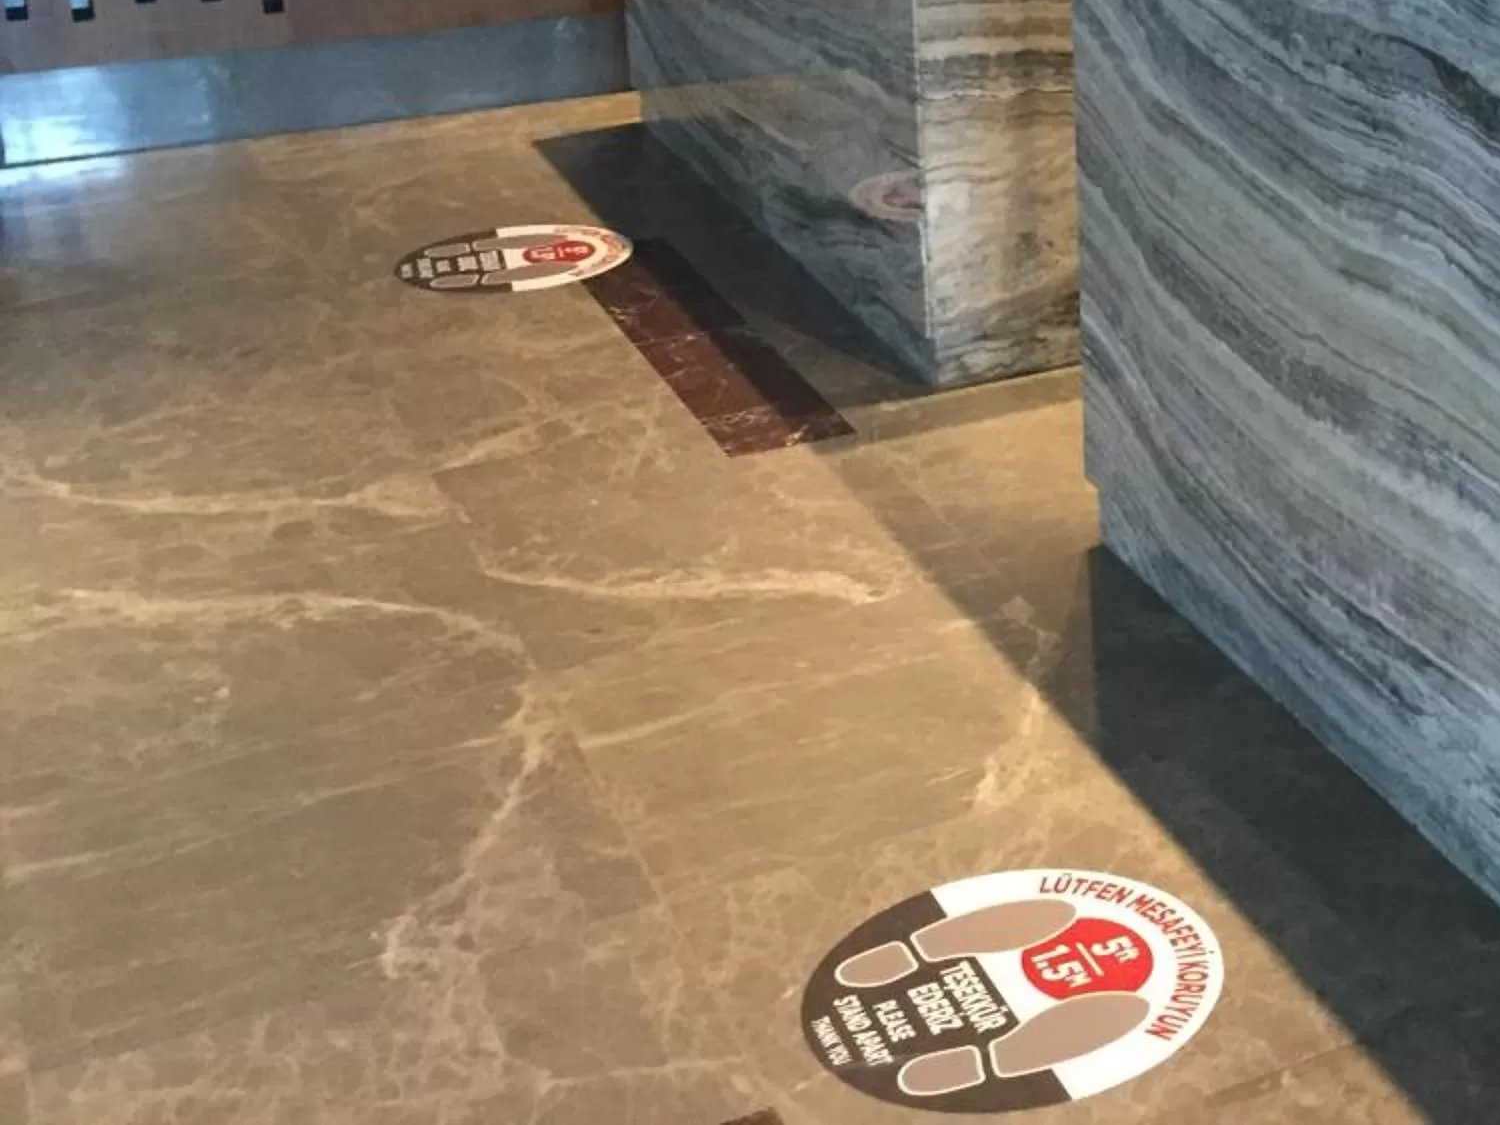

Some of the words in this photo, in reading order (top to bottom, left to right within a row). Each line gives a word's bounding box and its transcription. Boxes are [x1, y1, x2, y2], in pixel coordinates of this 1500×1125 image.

[1039, 873, 1134, 904] LÜTFEN
[1125, 893, 1215, 959] MESAFEYİ
[832, 994, 872, 1032] STAND
[872, 999, 917, 1043] PLEASE
[908, 981, 968, 1035] EDERİZ
[939, 961, 1009, 1033] TEŞEKKÜR
[1145, 960, 1210, 1041] KORUYUN
[851, 1030, 894, 1066] APART
